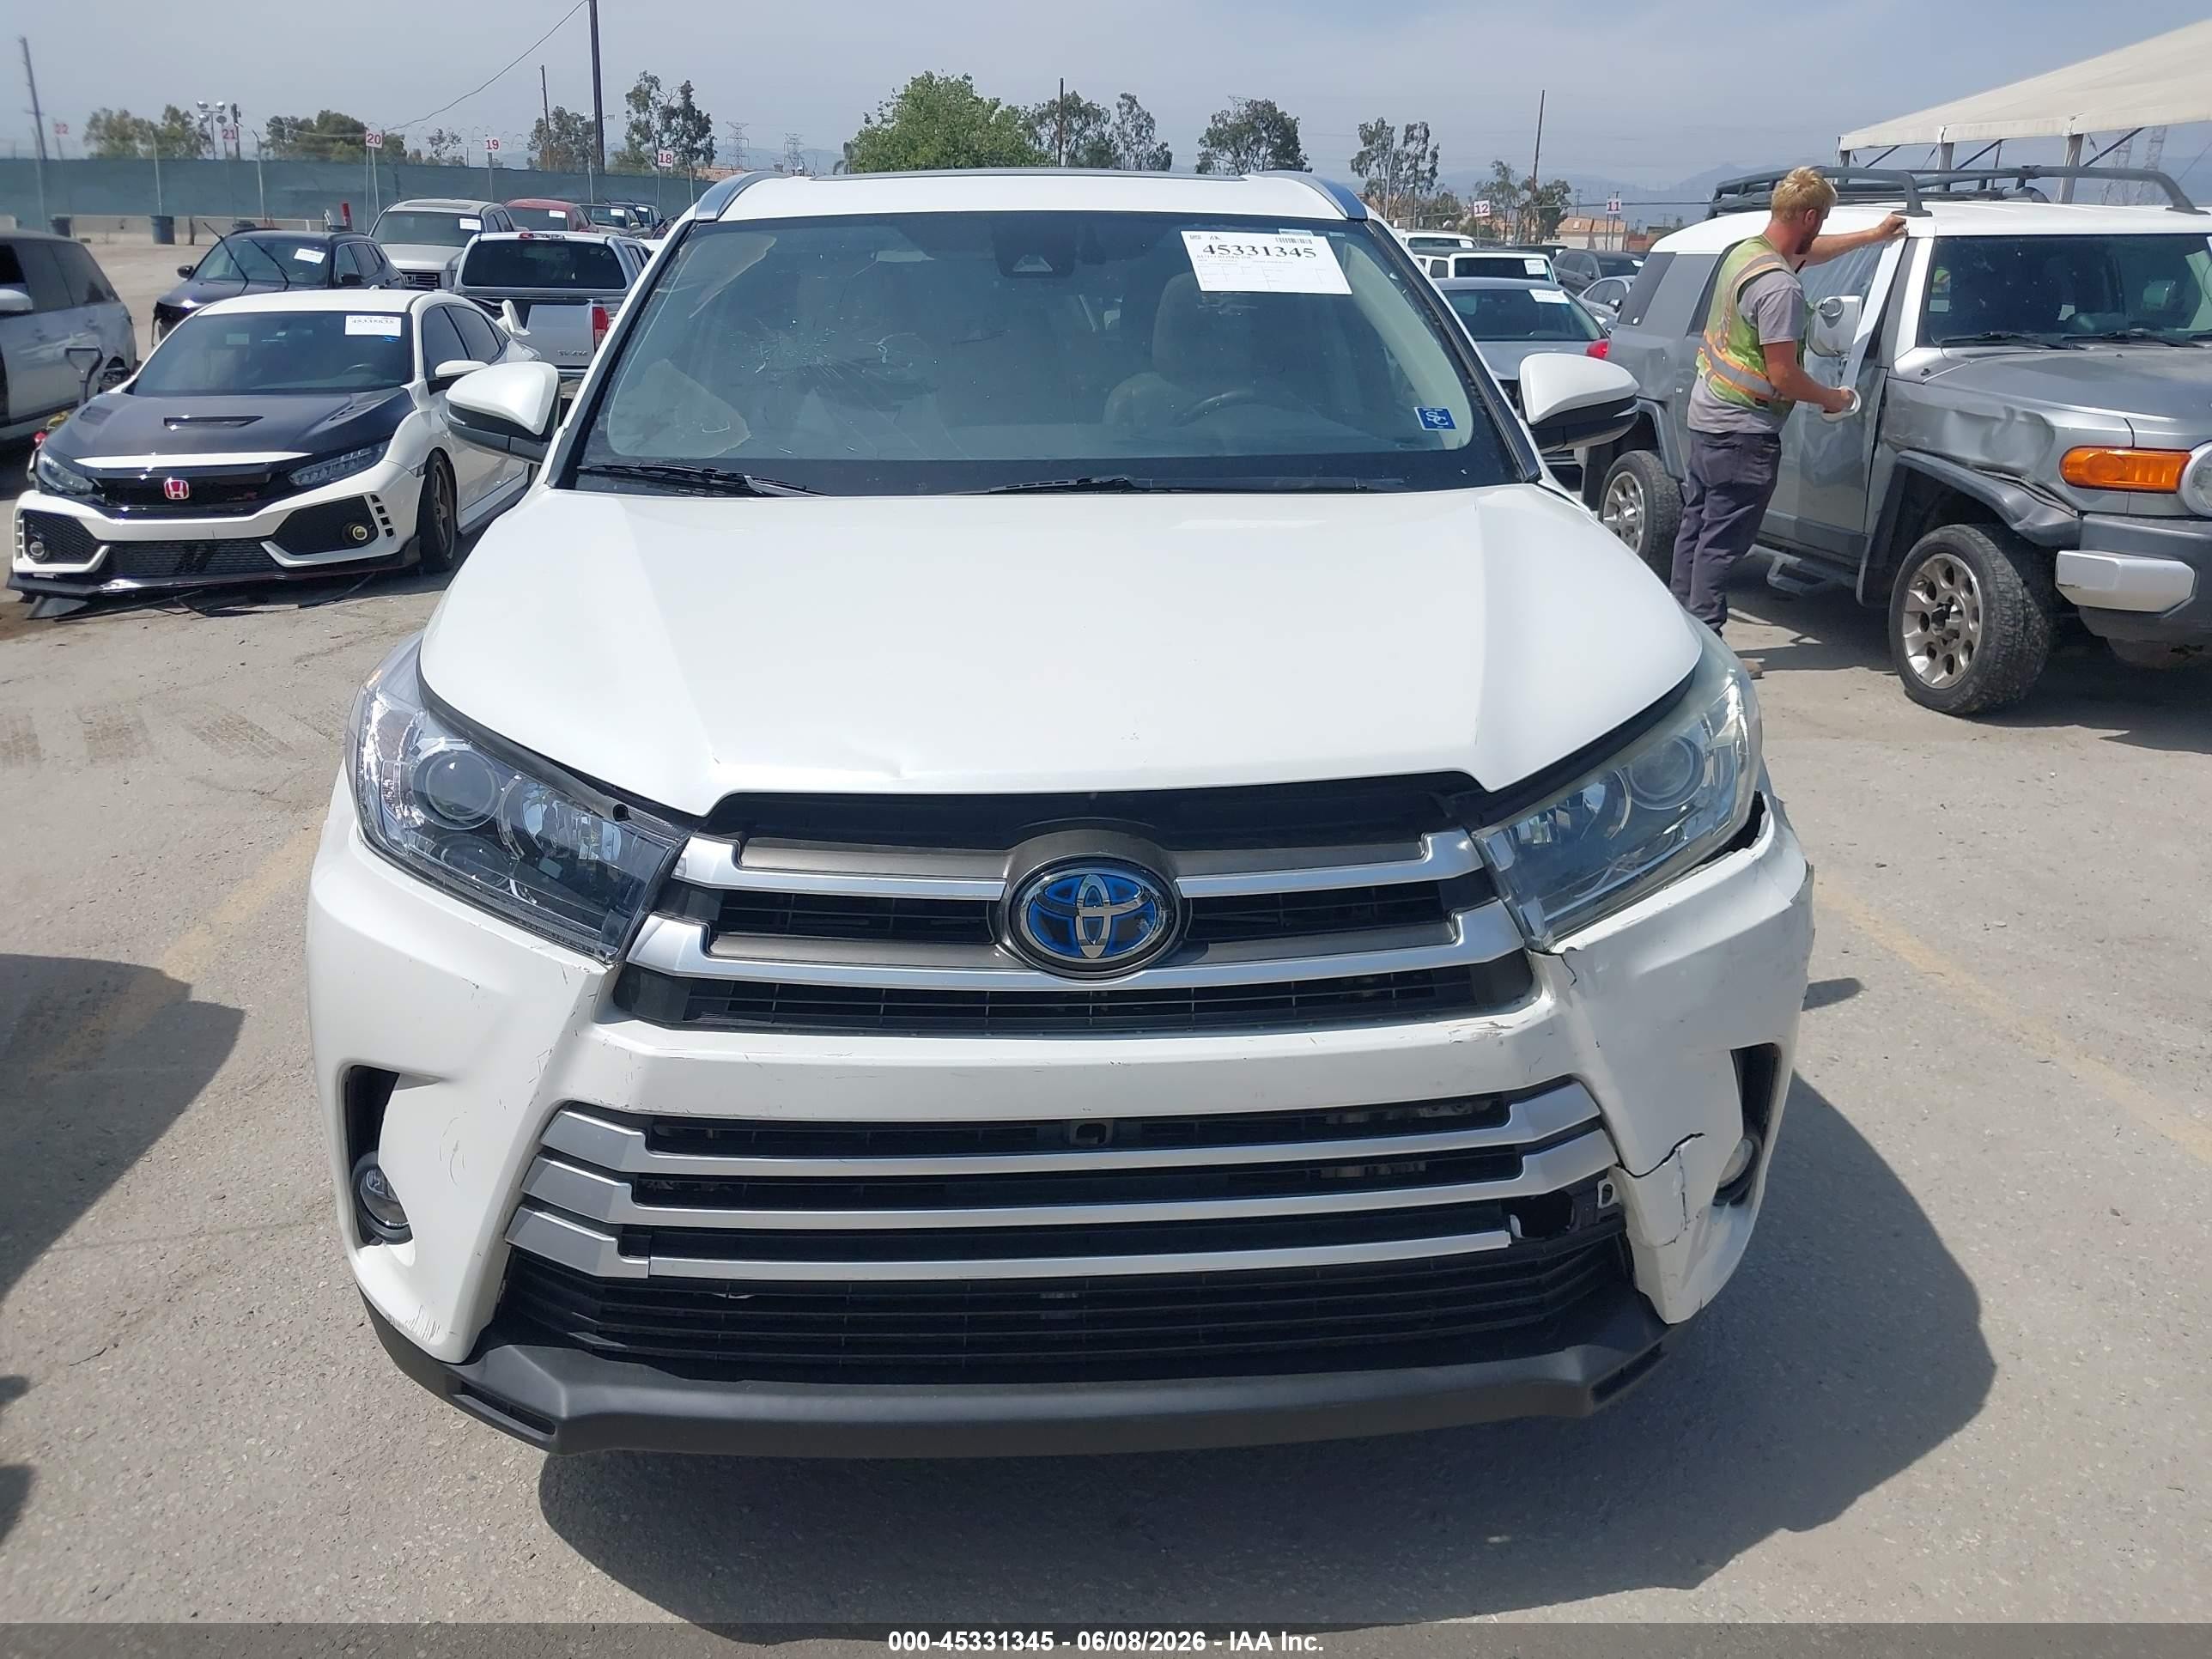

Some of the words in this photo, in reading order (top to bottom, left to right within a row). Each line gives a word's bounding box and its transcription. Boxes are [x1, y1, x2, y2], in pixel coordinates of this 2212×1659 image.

[222, 129, 236, 139] 21
[367, 133, 382, 146] 20
[486, 139, 500, 150] 19
[659, 153, 672, 165] 18
[1475, 204, 1489, 214] 12
[1607, 201, 1621, 211] 11
[1202, 244, 1316, 258] 45331345
